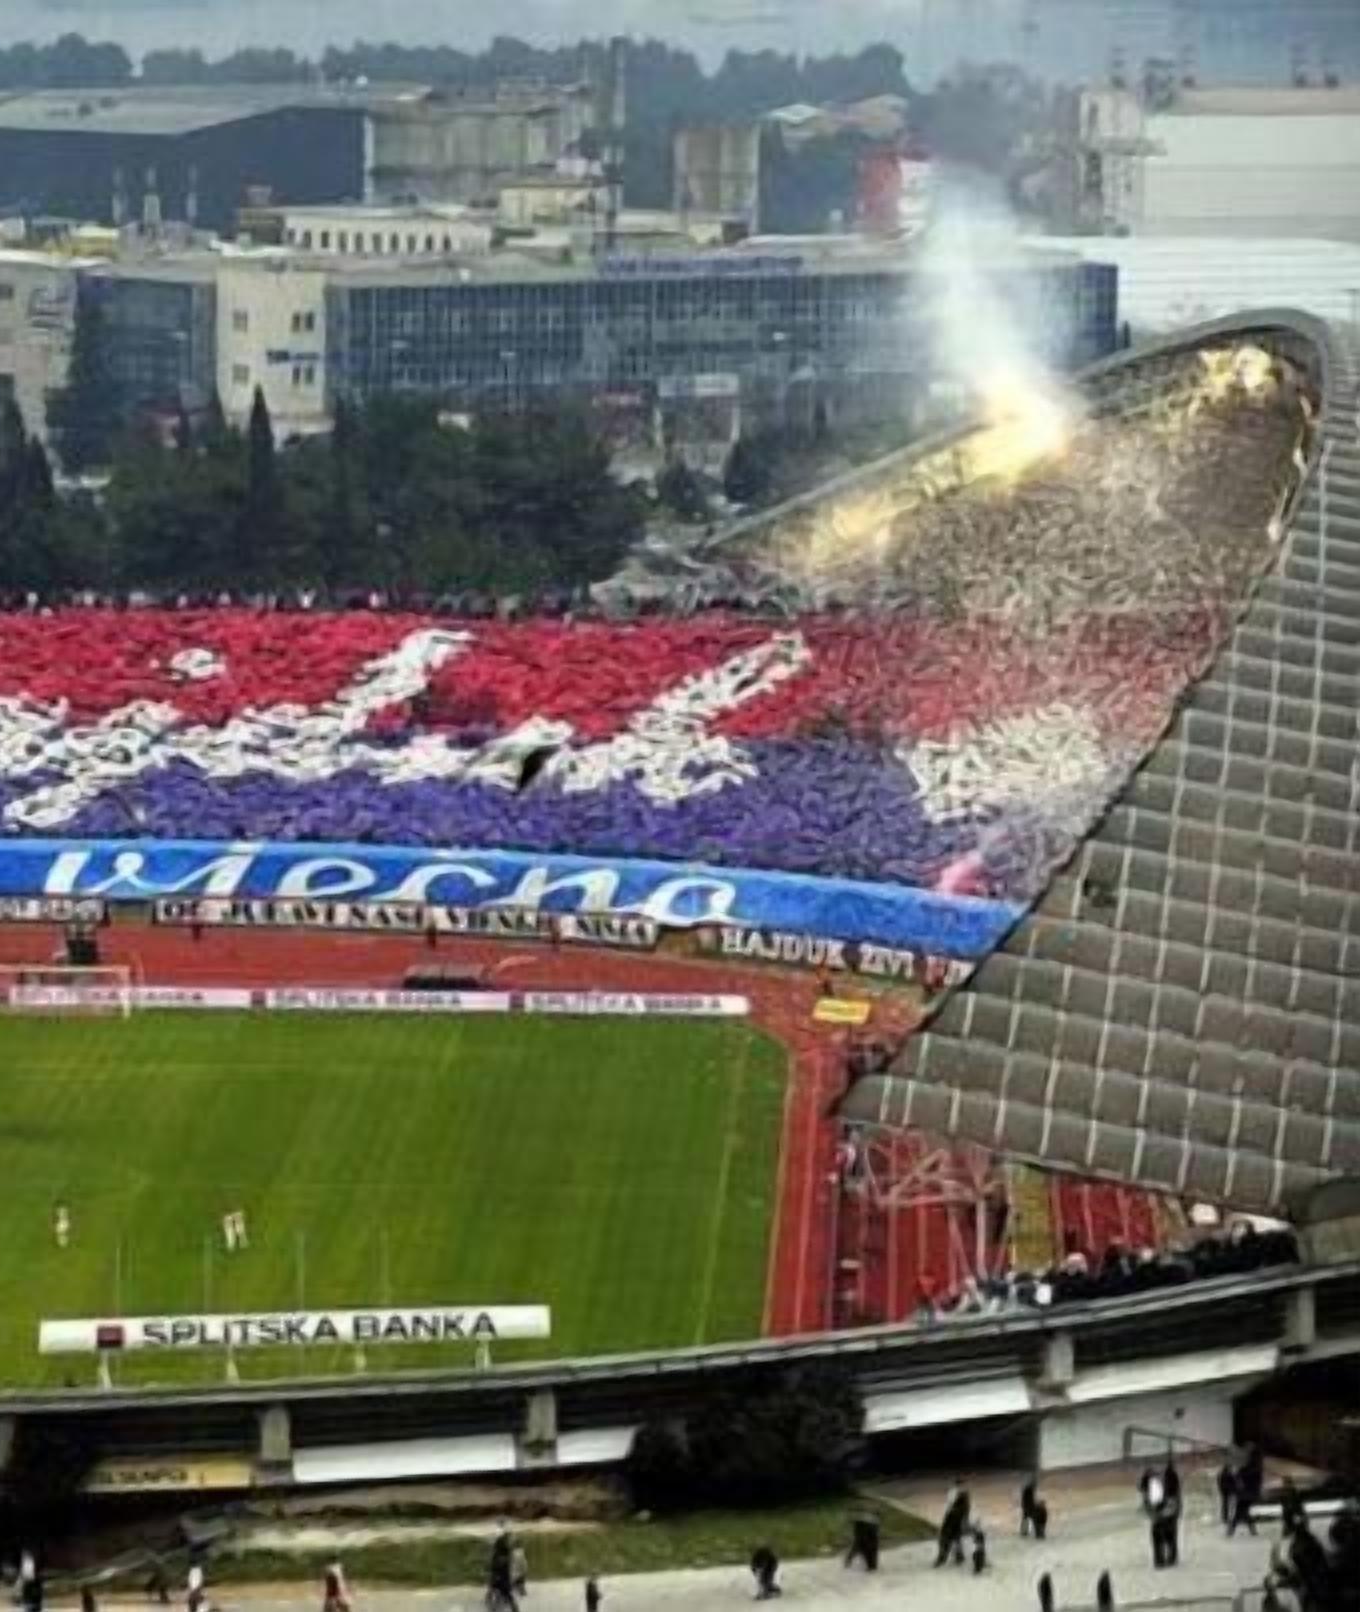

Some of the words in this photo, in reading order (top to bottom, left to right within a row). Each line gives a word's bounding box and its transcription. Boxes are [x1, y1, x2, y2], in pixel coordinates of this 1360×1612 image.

[721, 929, 848, 971] HAJDUK
[143, 1316, 339, 1348] SPLITSKA
[353, 1311, 498, 1341] BANKA
